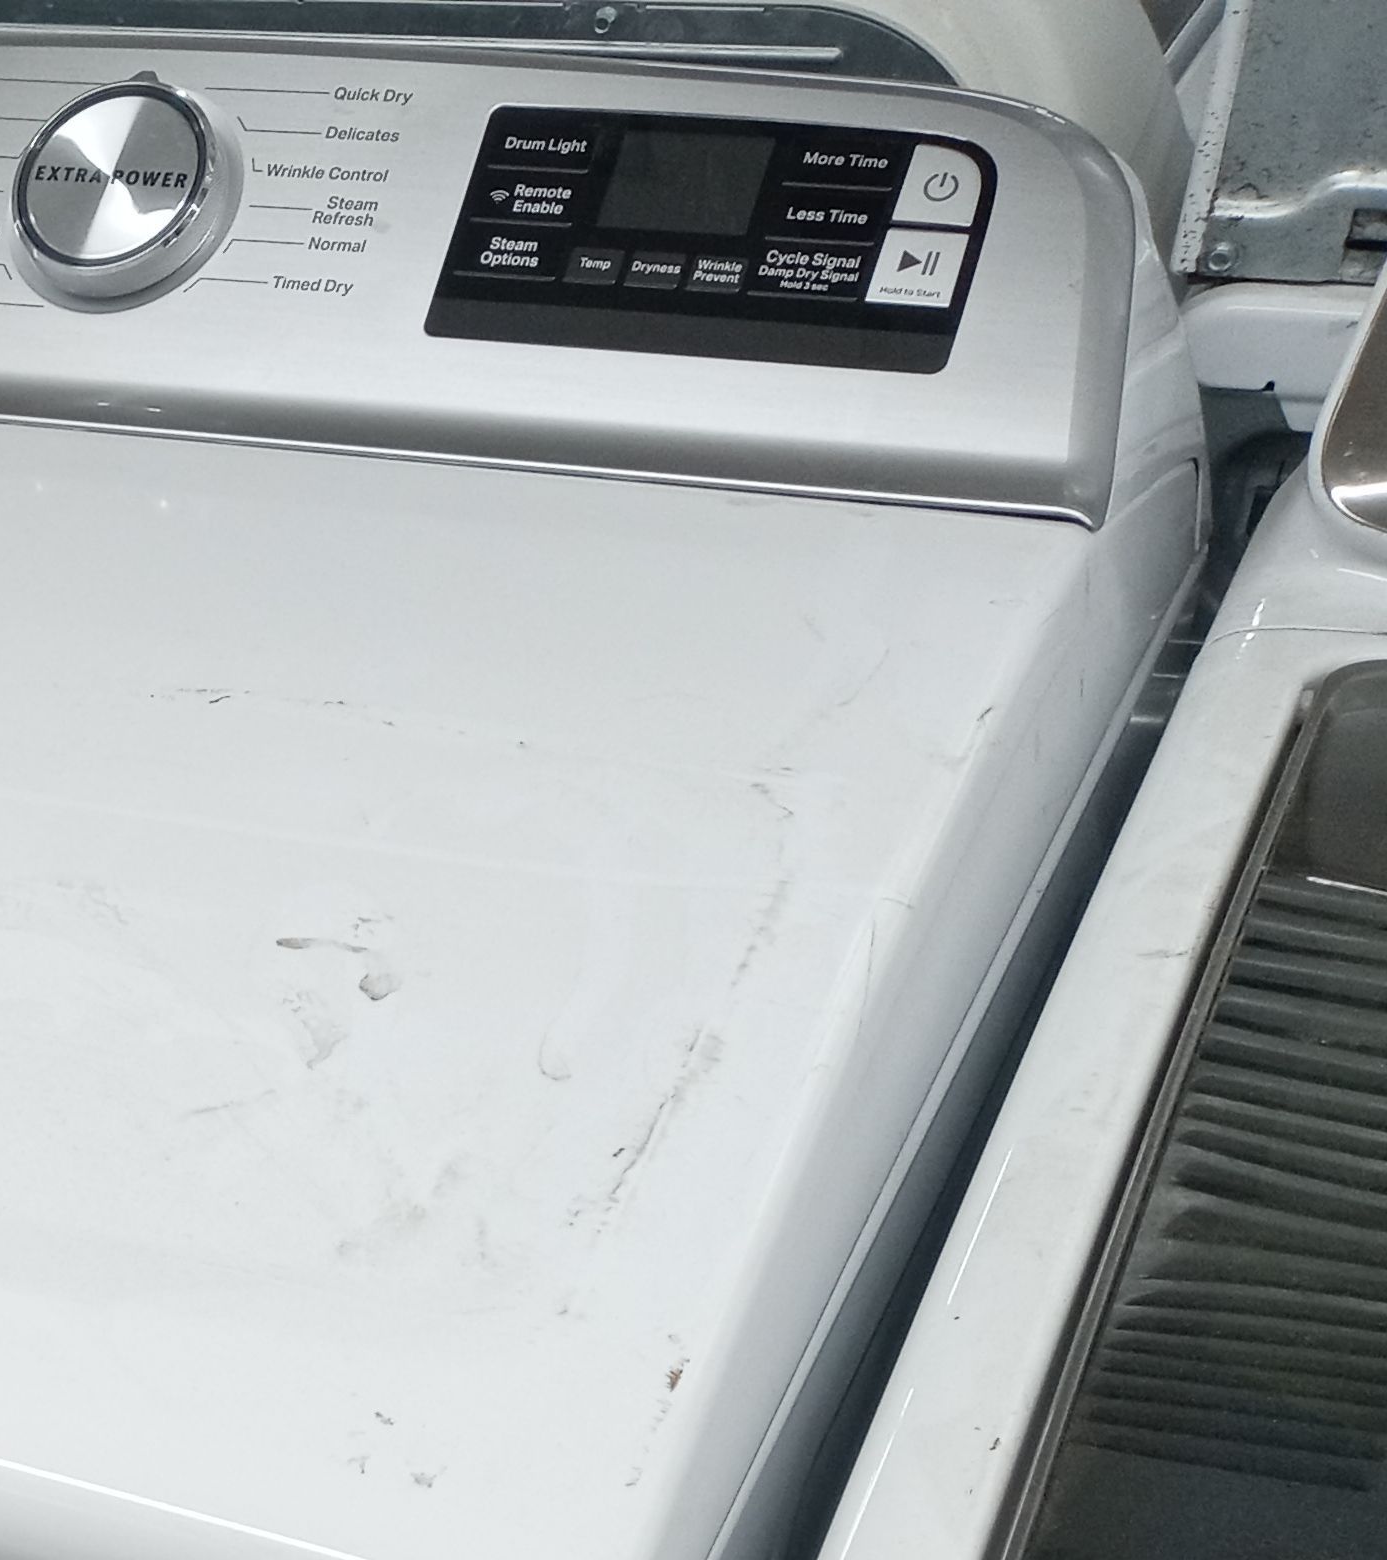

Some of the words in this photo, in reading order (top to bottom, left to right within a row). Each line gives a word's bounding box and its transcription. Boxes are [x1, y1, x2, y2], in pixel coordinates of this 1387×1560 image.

[334, 86, 380, 102] Quick
[383, 89, 413, 106] Dry
[325, 126, 399, 142] Delicates
[505, 136, 545, 151] Drum
[548, 138, 587, 154] Light
[803, 151, 845, 167] More
[850, 154, 888, 169] Time
[35, 165, 101, 183] EXTRA
[111, 170, 188, 188] POWER
[267, 163, 325, 180] Wrinkle
[328, 166, 389, 183] Control
[514, 184, 572, 199] Remote
[327, 196, 378, 211] Steam
[512, 199, 563, 215] Enable
[312, 211, 374, 227] Refresh
[786, 206, 824, 222] Less
[829, 209, 868, 225] Time
[308, 237, 367, 253] Normal
[489, 236, 538, 252] Steam
[480, 251, 539, 267] Options
[580, 257, 611, 271] Temp
[697, 259, 743, 273] Wrinkle
[766, 249, 809, 266] Cycle
[812, 252, 861, 270] Signal
[631, 260, 681, 275] Dryness
[758, 265, 793, 279] Damp
[796, 268, 818, 281] Dry
[820, 270, 859, 284] Signal
[693, 270, 740, 284] Prevent
[780, 280, 802, 289] Hold
[273, 275, 321, 291] Timed
[324, 279, 354, 296] Dry
[879, 286, 902, 295] Hold
[904, 288, 914, 296] to
[916, 289, 942, 298] Start
